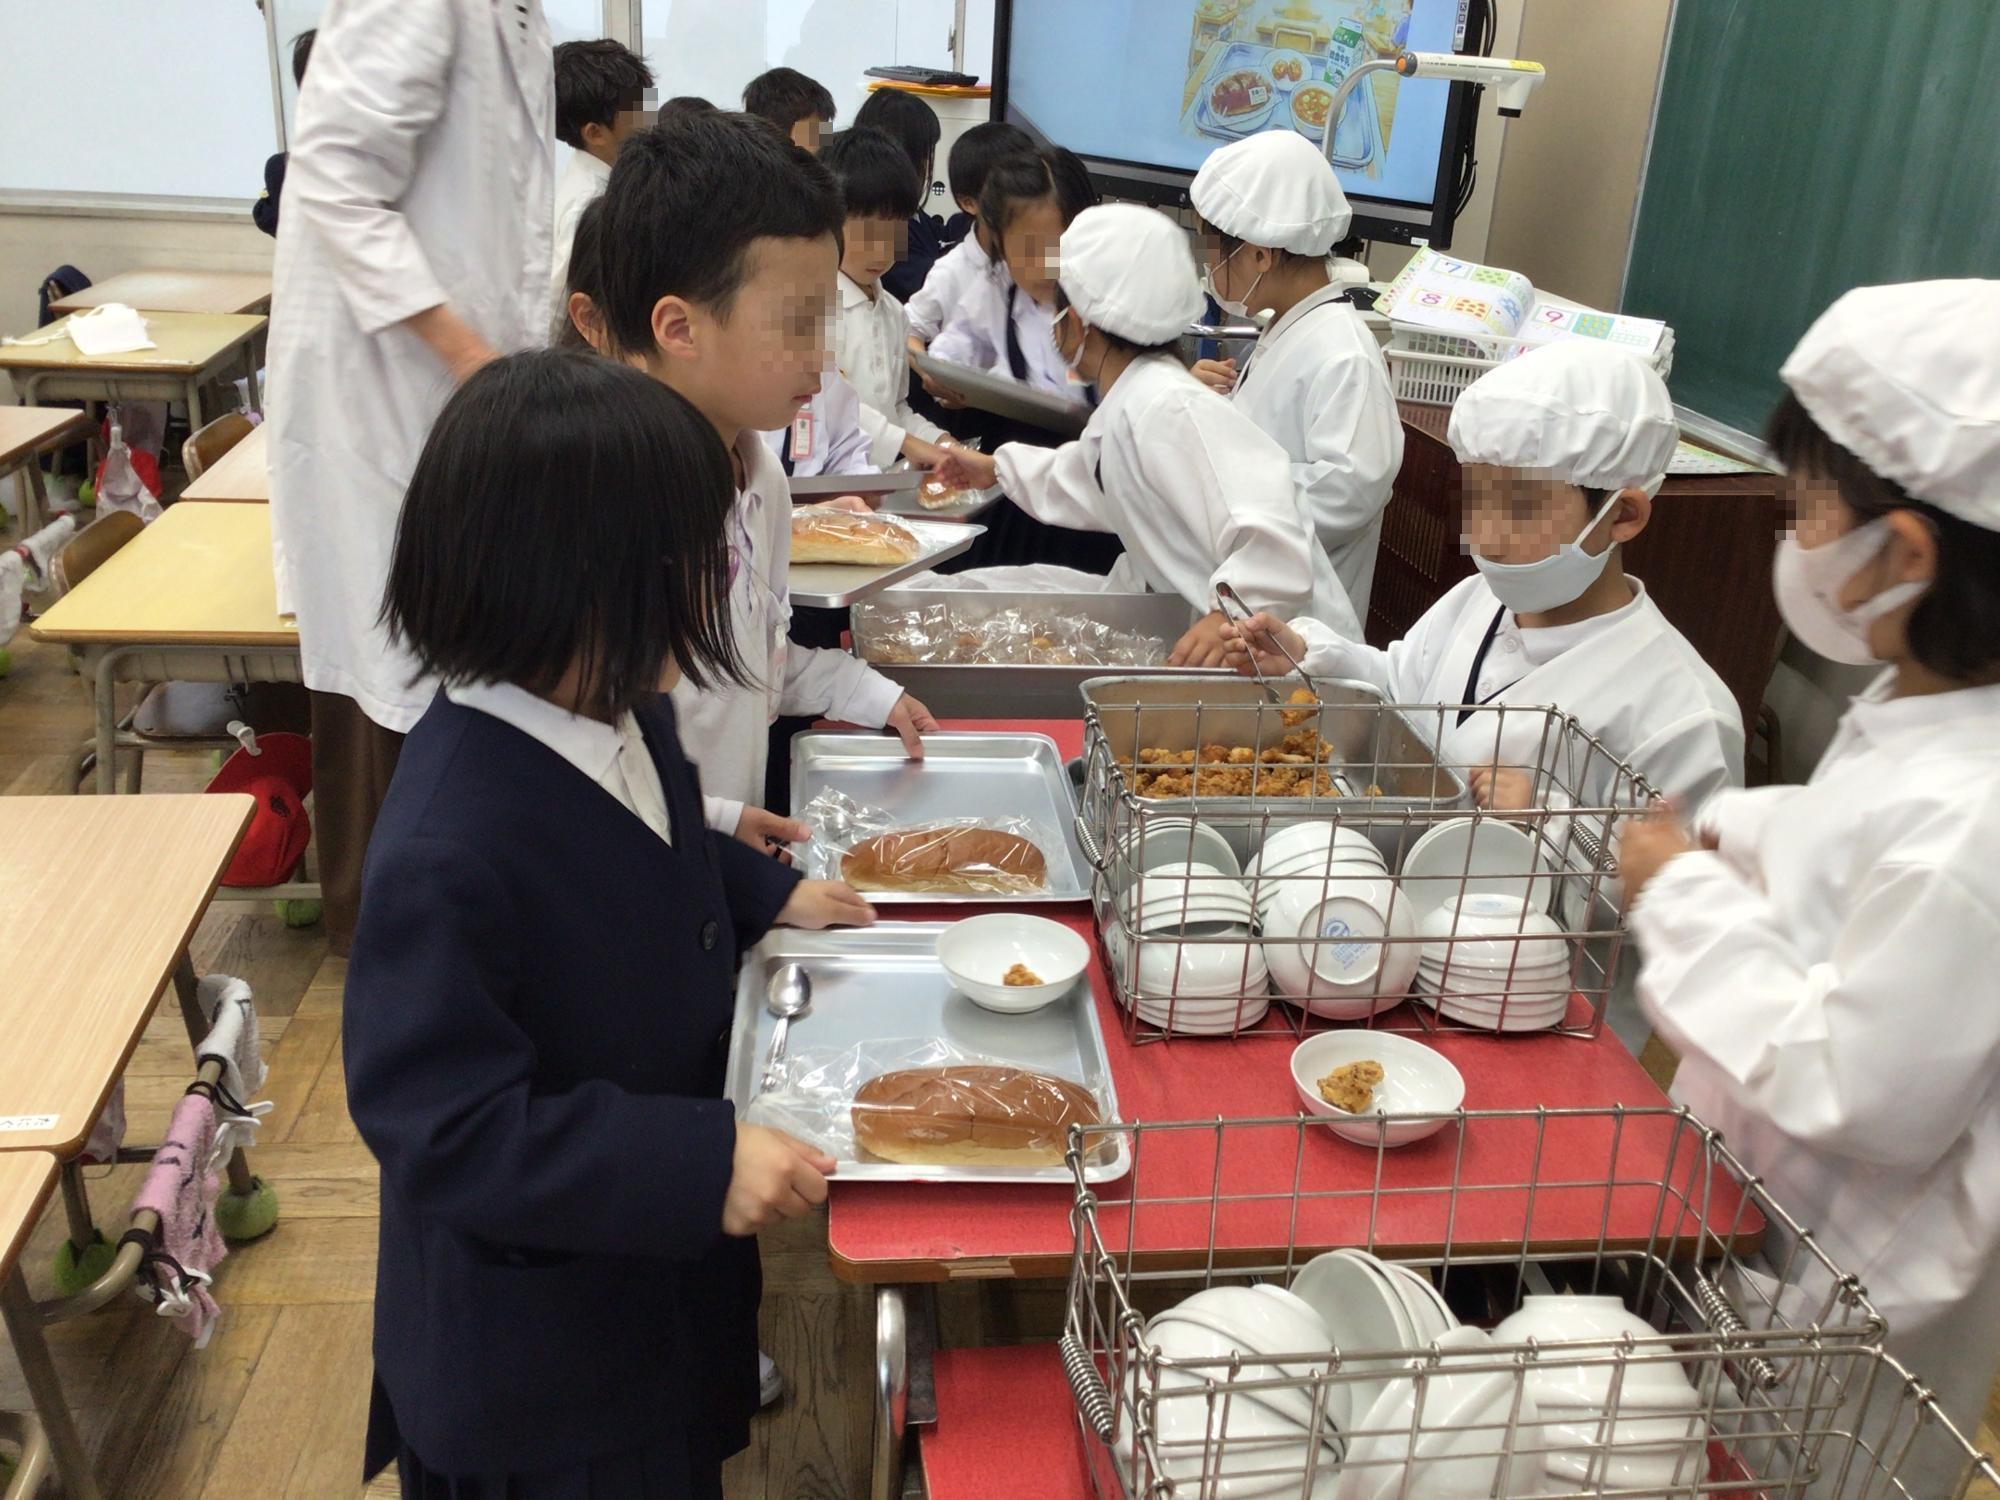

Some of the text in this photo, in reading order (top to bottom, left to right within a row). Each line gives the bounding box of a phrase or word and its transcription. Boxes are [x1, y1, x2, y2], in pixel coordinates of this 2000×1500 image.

[1445, 262, 1462, 273] 7
[1422, 293, 1441, 304] 8
[1546, 311, 1563, 322] 9
